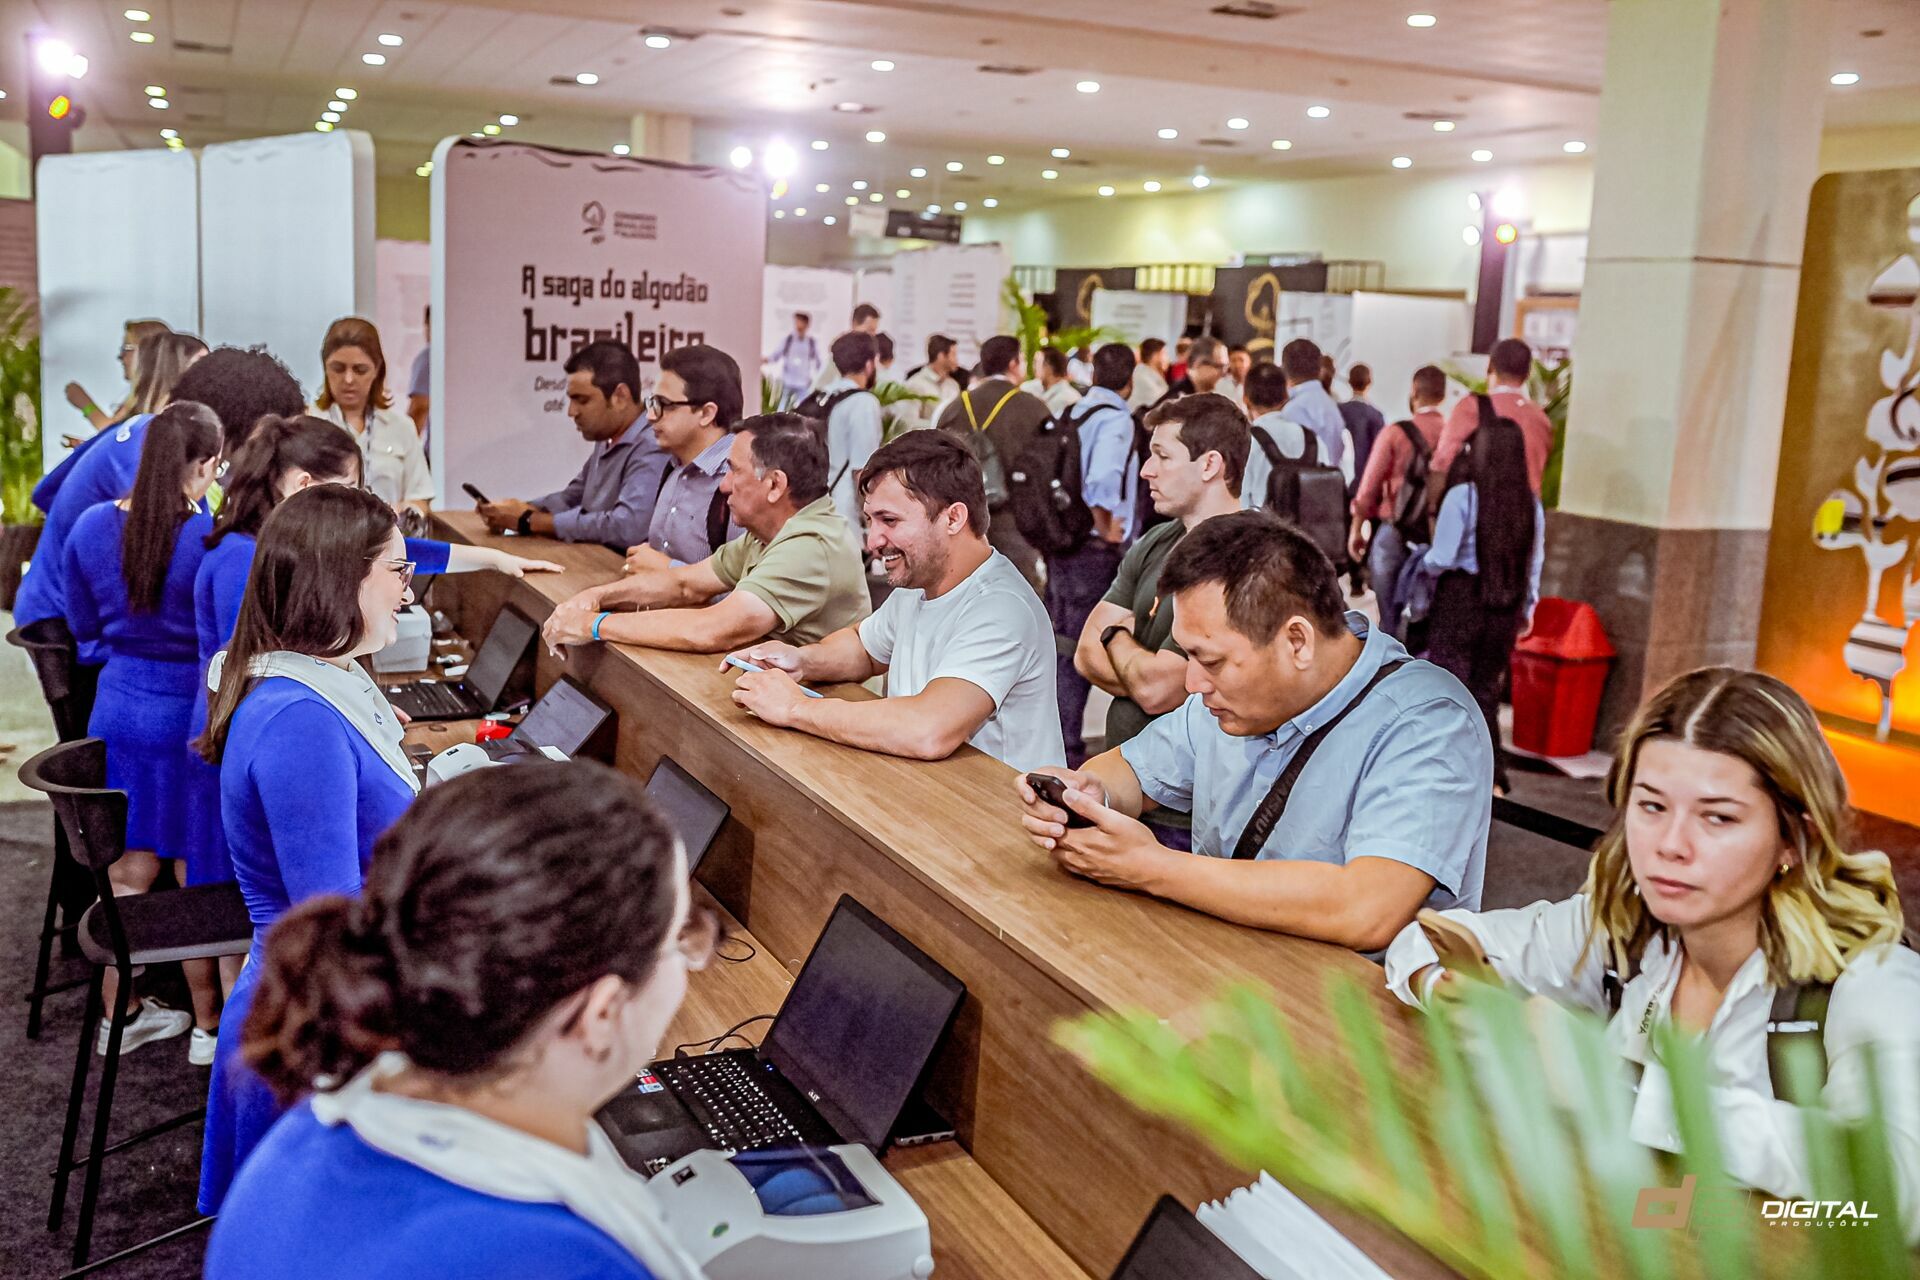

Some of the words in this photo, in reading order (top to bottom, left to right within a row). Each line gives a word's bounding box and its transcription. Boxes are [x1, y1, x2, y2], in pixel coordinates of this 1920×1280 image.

[522, 265, 535, 299] A
[543, 276, 594, 306] saga
[601, 268, 625, 298] do
[632, 270, 708, 309] algodão
